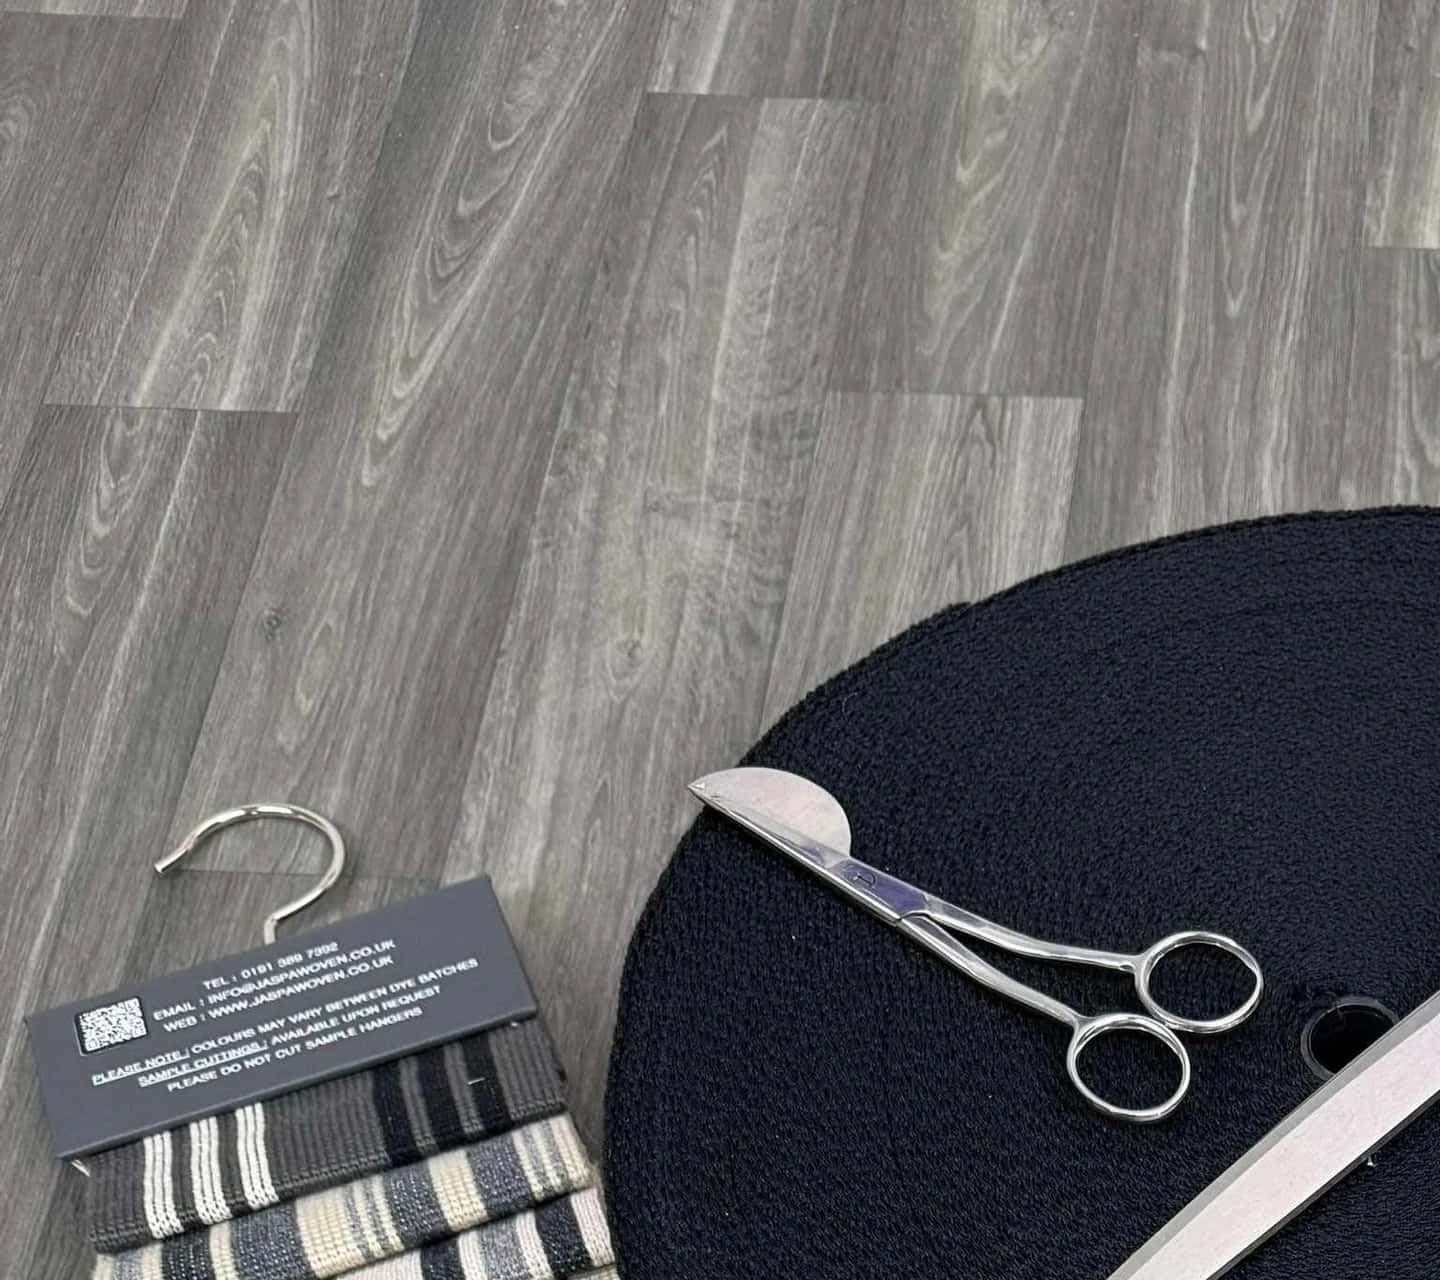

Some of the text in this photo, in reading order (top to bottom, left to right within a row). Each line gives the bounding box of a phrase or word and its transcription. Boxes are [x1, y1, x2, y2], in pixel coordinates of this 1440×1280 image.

[91, 1062, 141, 1086] PLEASE
[190, 1028, 256, 1053] COLOURS
[257, 1018, 286, 1033] MAY
[287, 1007, 322, 1023] VARY
[325, 986, 388, 1012] BETWEEN
[419, 958, 478, 983] BATCHES
[153, 1001, 196, 1021] EMAIL
[207, 939, 396, 1004] INFO@JASPAWOVEN.CO.UK
[163, 1015, 197, 1032] WEB
[207, 955, 394, 1018] WWW.JASPAWOVEN.CO.UK
[203, 977, 229, 990] TEL
[137, 1063, 192, 1087] SAMPLE
[271, 1017, 340, 1046] AVAILABLE
[341, 1004, 380, 1022] UPON
[381, 985, 441, 1010] REQUEST
[166, 1006, 423, 1092] PLEASE DO NOT CUT SAMPLE HANGERS
